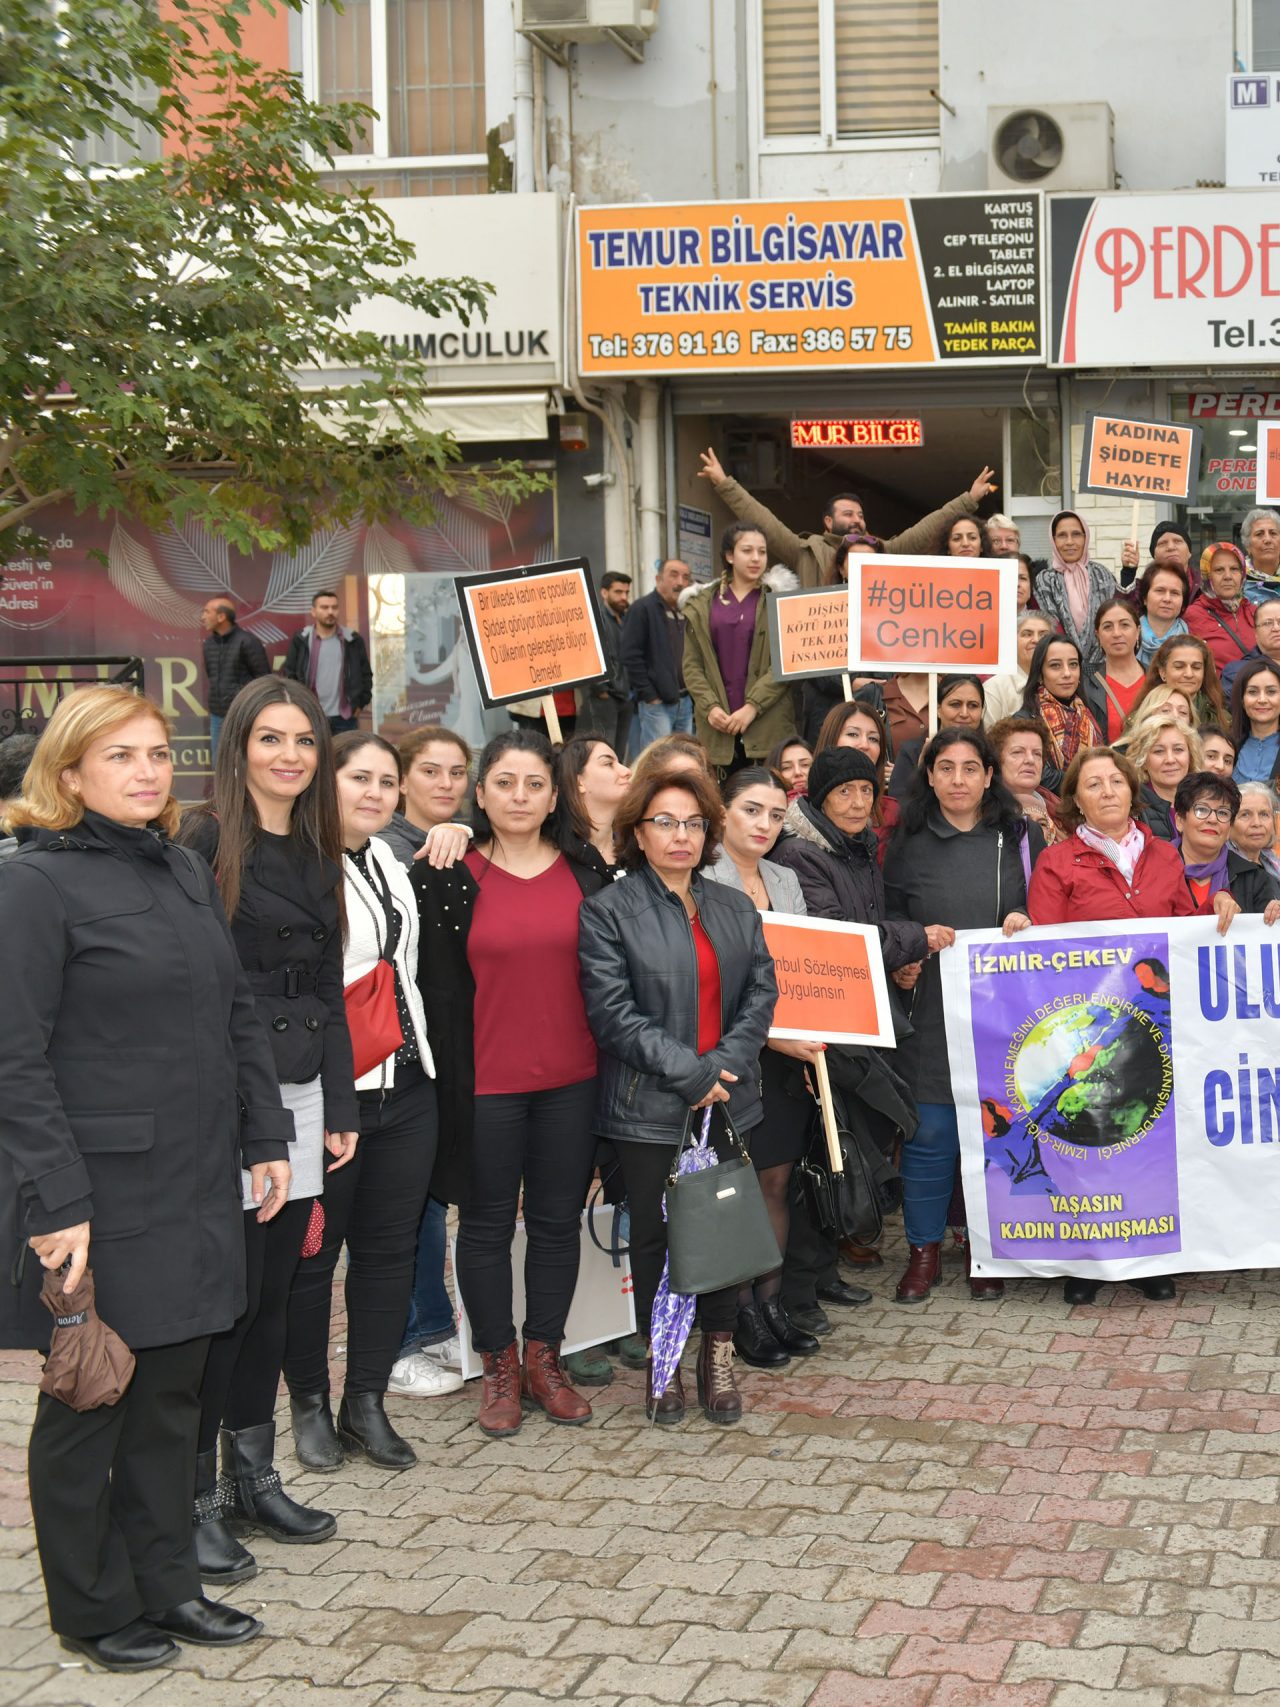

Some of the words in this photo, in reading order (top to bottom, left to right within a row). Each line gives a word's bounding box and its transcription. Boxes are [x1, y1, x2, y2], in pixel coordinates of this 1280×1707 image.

[984, 201, 1034, 217] KARTUŞ
[990, 217, 1034, 230] TONER
[588, 228, 701, 268] TEMUR
[711, 213, 906, 264] BİLGİSAYAR
[943, 234, 967, 247] CEP
[969, 232, 1034, 246] TELEFONU
[989, 247, 1034, 260] TABLET
[933, 265, 945, 277] 2.
[948, 265, 963, 277] EL
[965, 262, 1035, 276] BİLGİSAYAR
[639, 275, 742, 313] TEKNİK
[748, 271, 854, 310] SERVİS
[986, 279, 1035, 291] LAPTOP
[937, 296, 979, 308] ALINIR
[989, 294, 1035, 306] SATILIR
[943, 319, 988, 335] TAMİR
[991, 320, 1036, 333] BAKIM
[589, 333, 628, 358] Tel:
[632, 332, 674, 356] 376
[678, 331, 707, 355] 91
[712, 330, 740, 354] 16
[751, 330, 798, 353] Fax:
[802, 327, 845, 351] 386
[850, 326, 877, 350] 57
[883, 326, 913, 350] 75
[943, 339, 988, 352] YEDEK
[991, 337, 1036, 353] PARÇA
[1105, 422, 1181, 445] KADINA
[1099, 445, 1182, 470] ŞİDDETE
[1105, 470, 1171, 492] HAYIR!
[477, 592, 491, 612] Bir
[537, 586, 546, 601] ve
[547, 578, 577, 604] çocuklar
[867, 580, 993, 616] #güleda
[482, 616, 508, 643] Şiddet
[801, 635, 824, 648] TEK
[876, 619, 985, 650] Cenkel
[490, 646, 499, 665] O
[565, 631, 588, 652] ölüyor
[803, 957, 871, 982] Sözleşmesi
[974, 946, 1134, 975] İZMİR-ÇEKEV
[778, 978, 846, 1001] Uygulansın
[1034, 992, 1151, 1027] DEĞERLENDİRME
[1148, 1023, 1164, 1043] VE
[1005, 1073, 1025, 1115] KADIN
[1149, 1044, 1174, 1120] DAYANIŞMA
[1049, 1193, 1123, 1218] YAŞASIN
[1000, 1221, 1056, 1240] KADIN
[1058, 1215, 1175, 1243] DAYANIŞMASI
